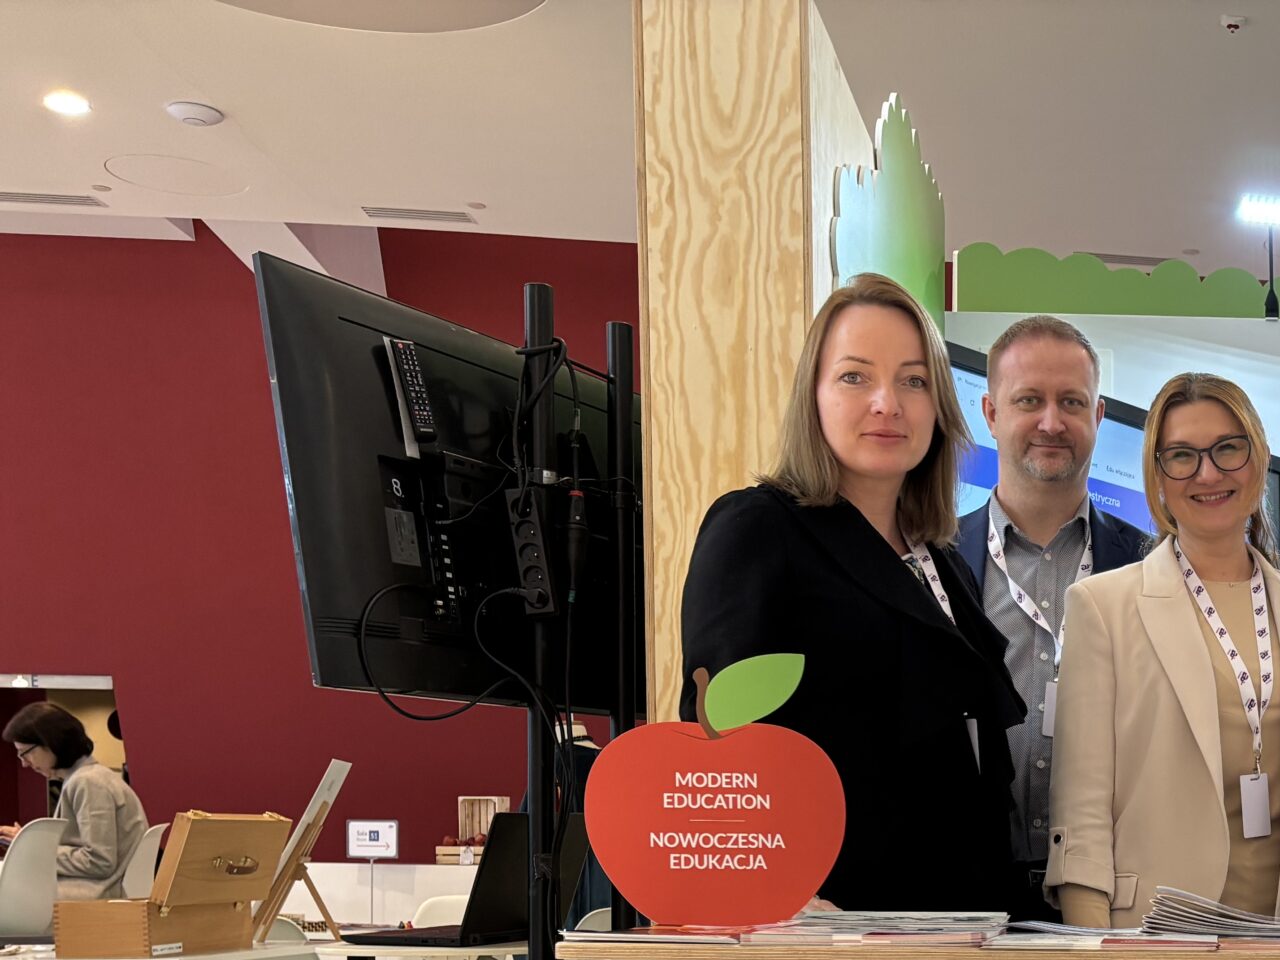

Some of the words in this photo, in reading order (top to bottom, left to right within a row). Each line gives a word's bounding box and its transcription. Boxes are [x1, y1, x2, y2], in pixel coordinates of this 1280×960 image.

[675, 772, 758, 789] MODERN
[663, 792, 771, 810] EDUCATION
[649, 831, 786, 850] NOWOCZESNA
[669, 853, 768, 870] EDUKACJA
